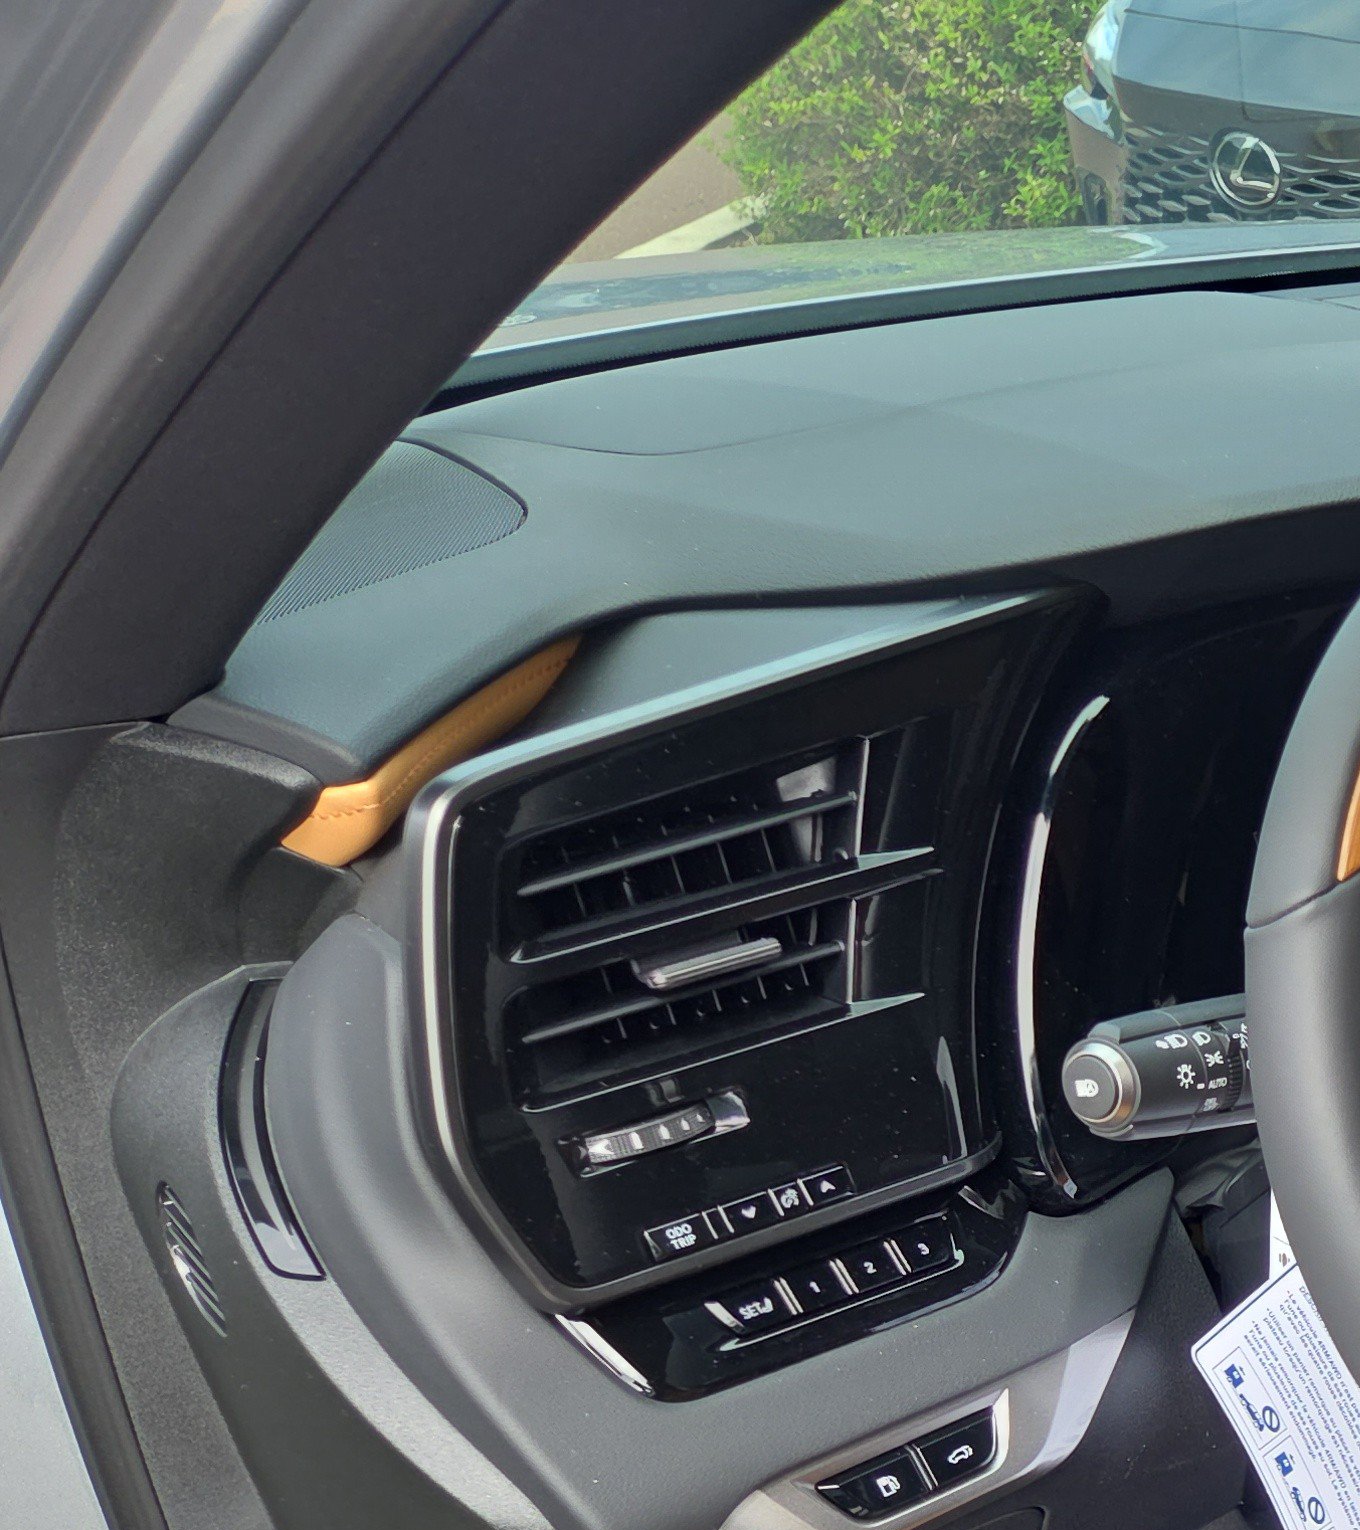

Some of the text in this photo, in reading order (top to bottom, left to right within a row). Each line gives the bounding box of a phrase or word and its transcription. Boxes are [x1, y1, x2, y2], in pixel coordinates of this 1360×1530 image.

[1208, 1077, 1228, 1089] AUTO
[666, 1223, 692, 1239] ODO
[670, 1234, 697, 1250] TRIP
[917, 1242, 930, 1256] 3
[809, 1281, 820, 1293] 1
[863, 1261, 877, 1275] 2
[738, 1301, 764, 1320] SET
[1258, 1357, 1290, 1409] sérieusement
[1262, 1317, 1283, 1345] plateau
[1305, 1385, 1332, 1433] remorquage
[1331, 1435, 1339, 1447] est
[1296, 1305, 1317, 1338] véhicule
[1350, 1402, 1360, 1417] pas
[1299, 1334, 1308, 1347] les
[1307, 1349, 1323, 1374] quatre
[1322, 1376, 1336, 1399] roues
[1336, 1400, 1357, 1439] décollées
[1303, 1332, 1327, 1369] plusieurs
[1333, 1382, 1342, 1397] ses
[1342, 1398, 1355, 1422] roues
[1259, 1336, 1278, 1361] jamais
[1277, 1363, 1303, 1402] remorquer
[1307, 1414, 1325, 1447] véhicule
[1292, 1352, 1309, 1375] panier
[1308, 1378, 1330, 1415] remorque
[1334, 1429, 1350, 1453] placer
[1268, 1362, 1291, 1398] plusieurs
[1297, 1411, 1306, 1425] ses
[1305, 1427, 1318, 1449] roues
[1336, 1492, 1353, 1525] système
